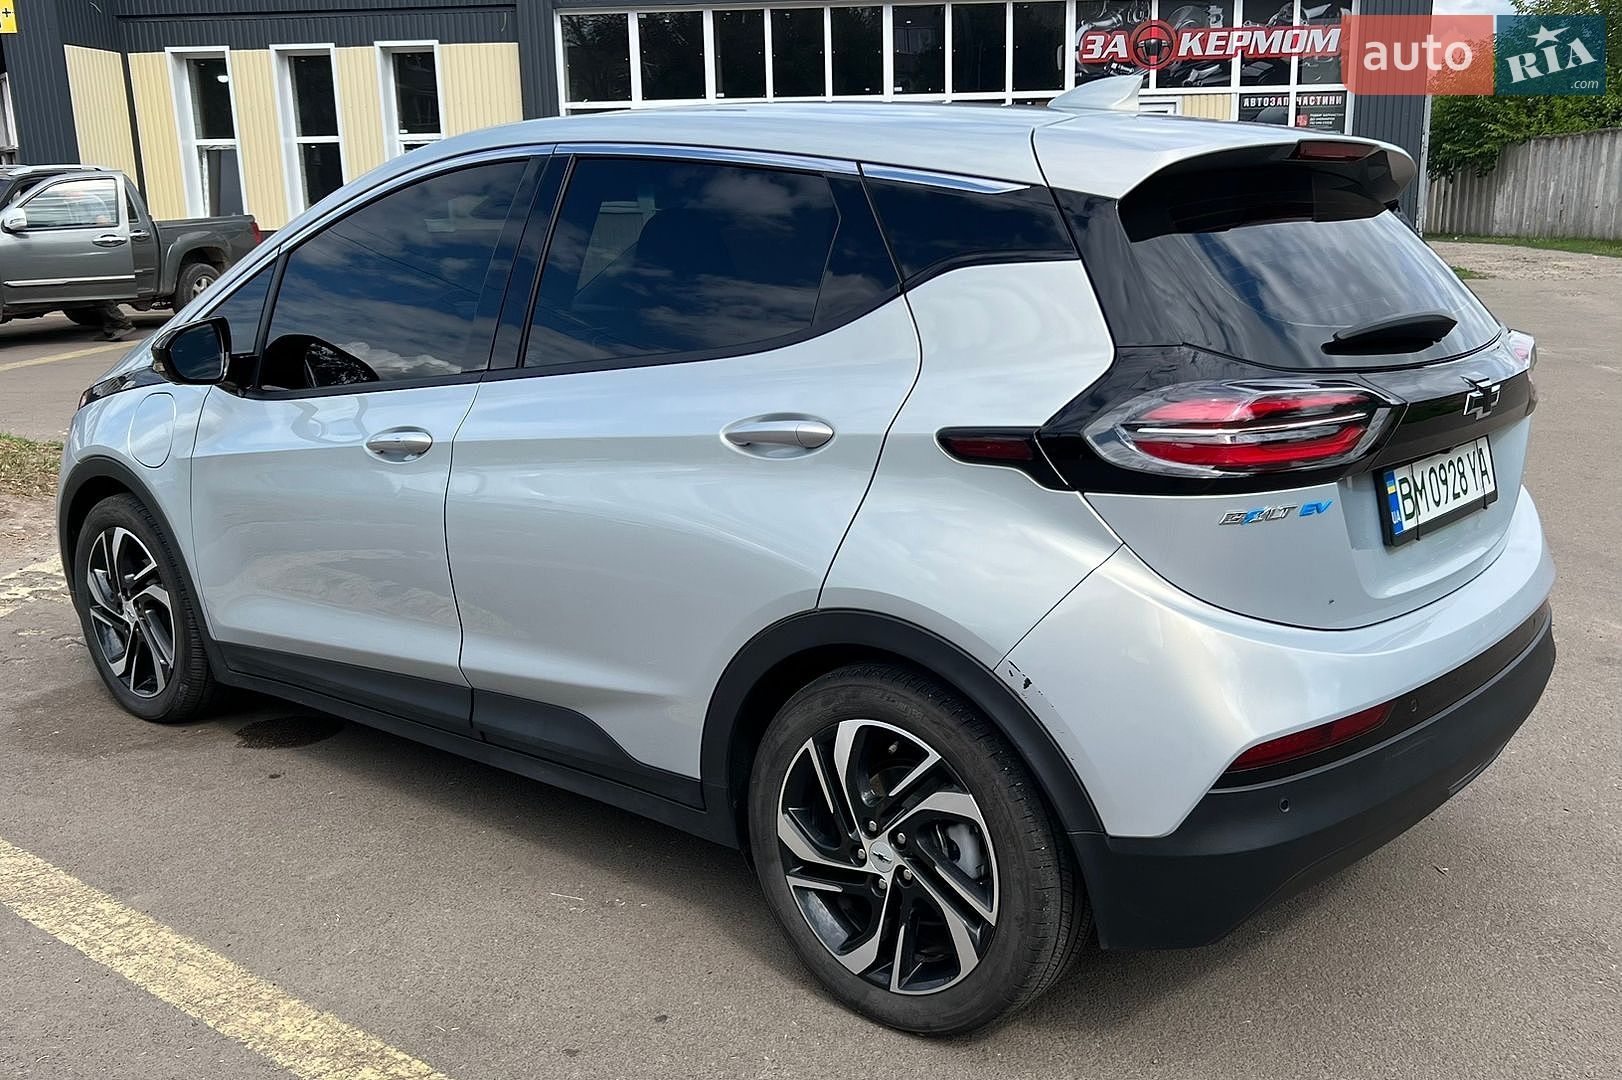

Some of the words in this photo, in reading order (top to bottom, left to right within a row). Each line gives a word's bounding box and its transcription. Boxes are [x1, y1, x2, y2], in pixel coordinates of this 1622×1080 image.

[1082, 34, 1128, 59] ЗА
[1178, 28, 1341, 57] КЕРМОМ
[1299, 498, 1334, 517] EV
